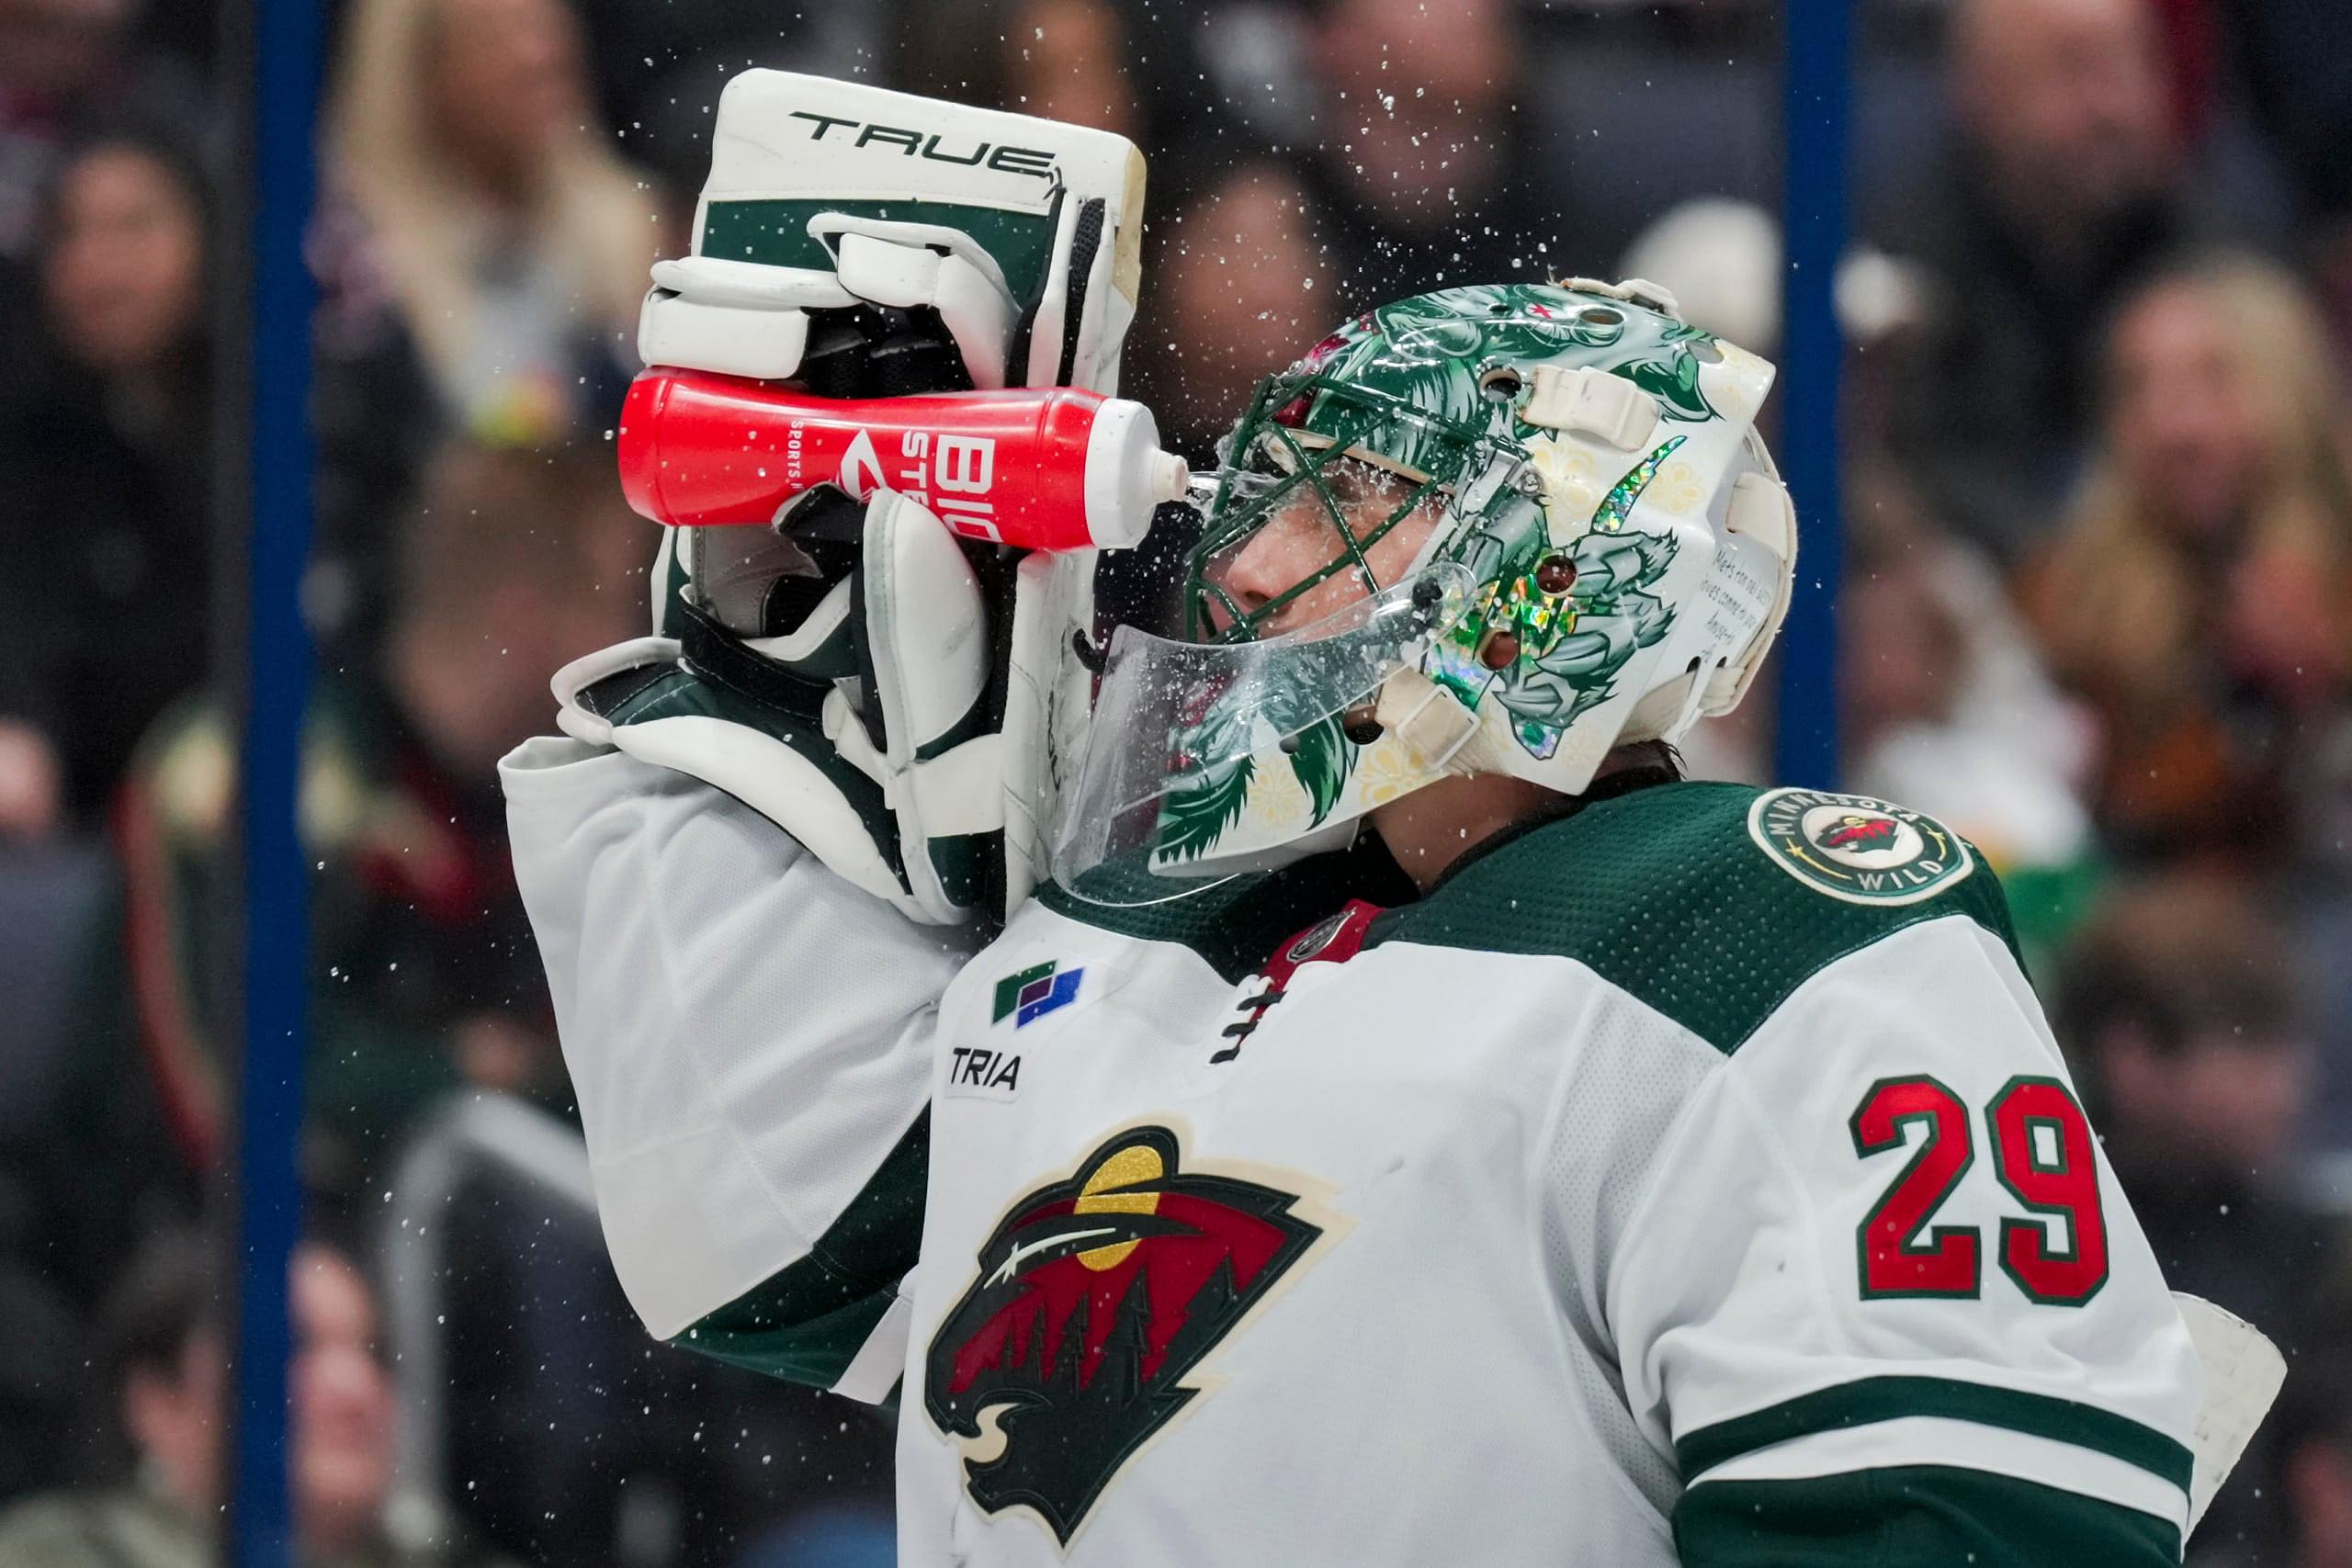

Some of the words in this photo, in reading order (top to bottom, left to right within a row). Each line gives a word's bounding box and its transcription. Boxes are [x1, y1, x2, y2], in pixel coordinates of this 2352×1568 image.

[788, 111, 1057, 178] TRUE
[787, 420, 804, 479] SPORTS
[1767, 793, 1919, 836] MINNESOTA
[1858, 860, 1945, 891] WILD
[951, 1047, 1022, 1091] TRIA
[1848, 1073, 2109, 1308] 29
